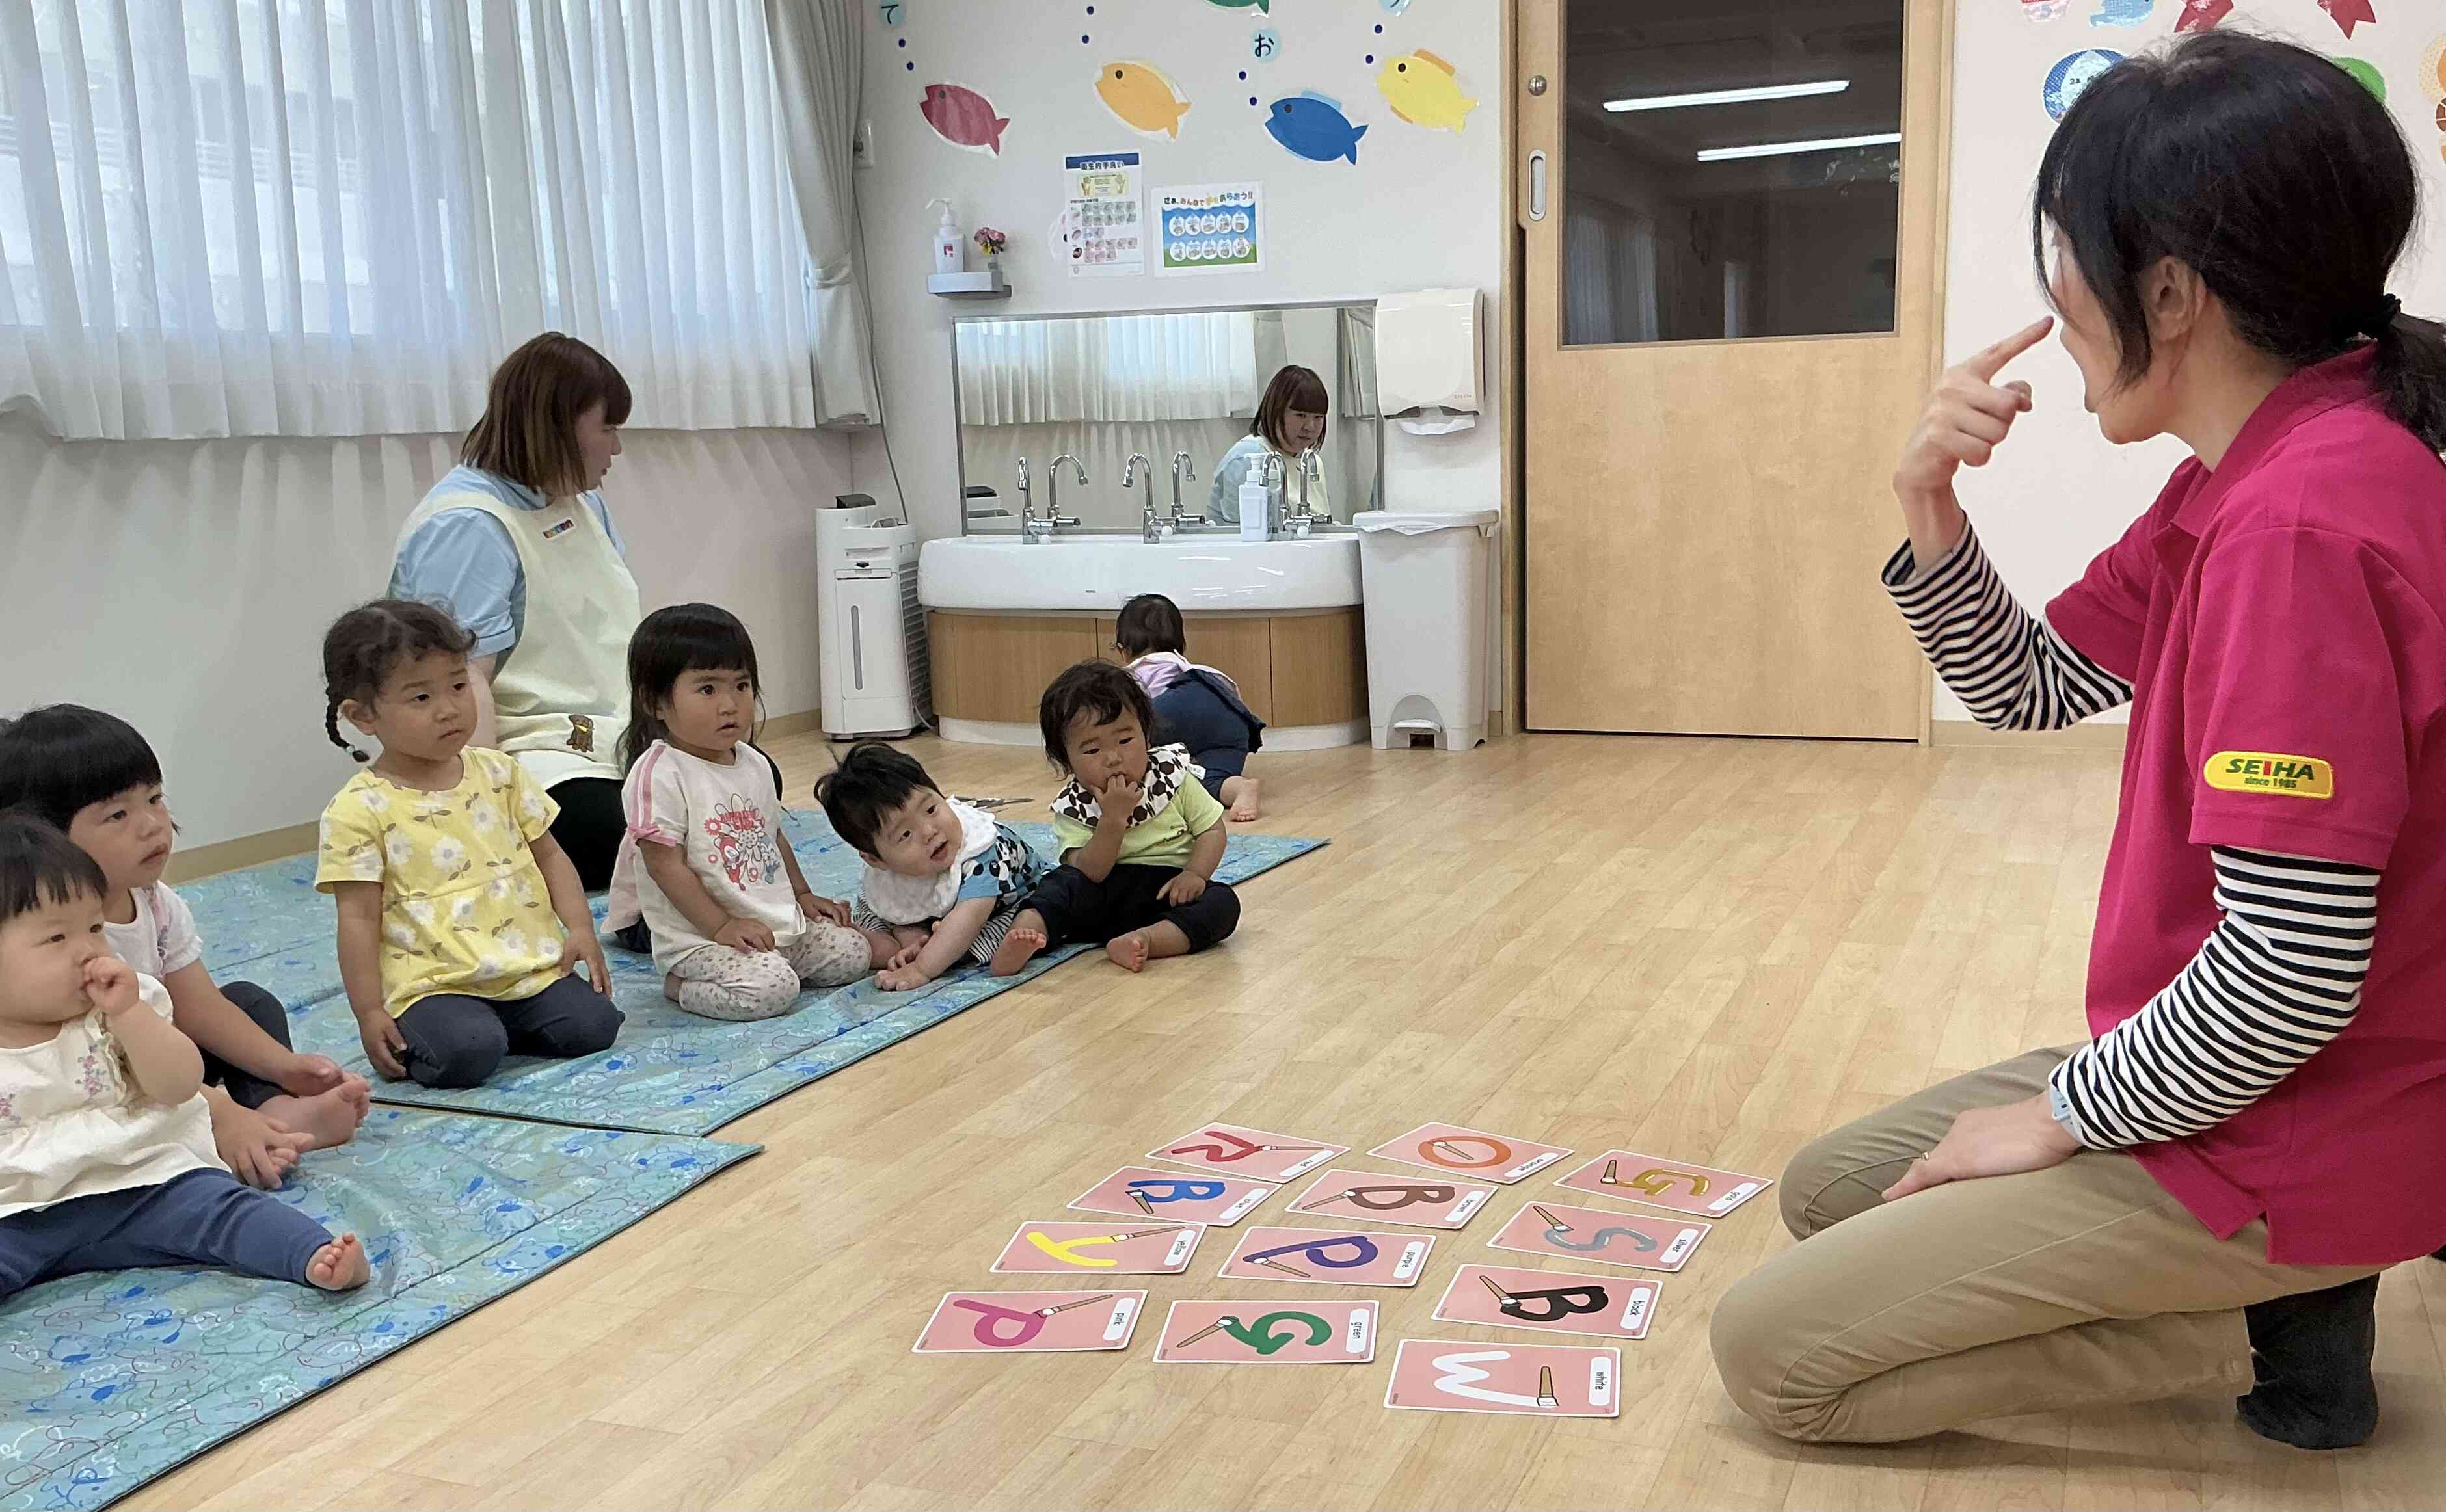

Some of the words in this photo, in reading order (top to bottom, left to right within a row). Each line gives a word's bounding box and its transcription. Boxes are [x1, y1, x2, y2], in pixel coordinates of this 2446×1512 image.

[880, 3, 899, 25] て
[1254, 33, 1275, 58] お
[2225, 758, 2315, 780] SEIHA
[2244, 776, 2270, 786] since
[1172, 1130, 1264, 1162] R
[1418, 1135, 1512, 1168] O
[1127, 1180, 1226, 1203] B
[1347, 1185, 1456, 1210] B
[1025, 1231, 1118, 1267] Y
[1172, 1240, 1187, 1256] yellow
[1242, 1236, 1378, 1269] P
[1544, 1227, 1658, 1253] S
[1401, 1251, 1416, 1268] purple
[1499, 1285, 1609, 1322] B
[1629, 1300, 1645, 1316] black
[953, 1299, 1046, 1347] P
[1113, 1312, 1125, 1325] pink
[1351, 1321, 1362, 1339] green
[1220, 1310, 1333, 1355] G
[1431, 1350, 1555, 1407] W
[1594, 1371, 1607, 1390] white
